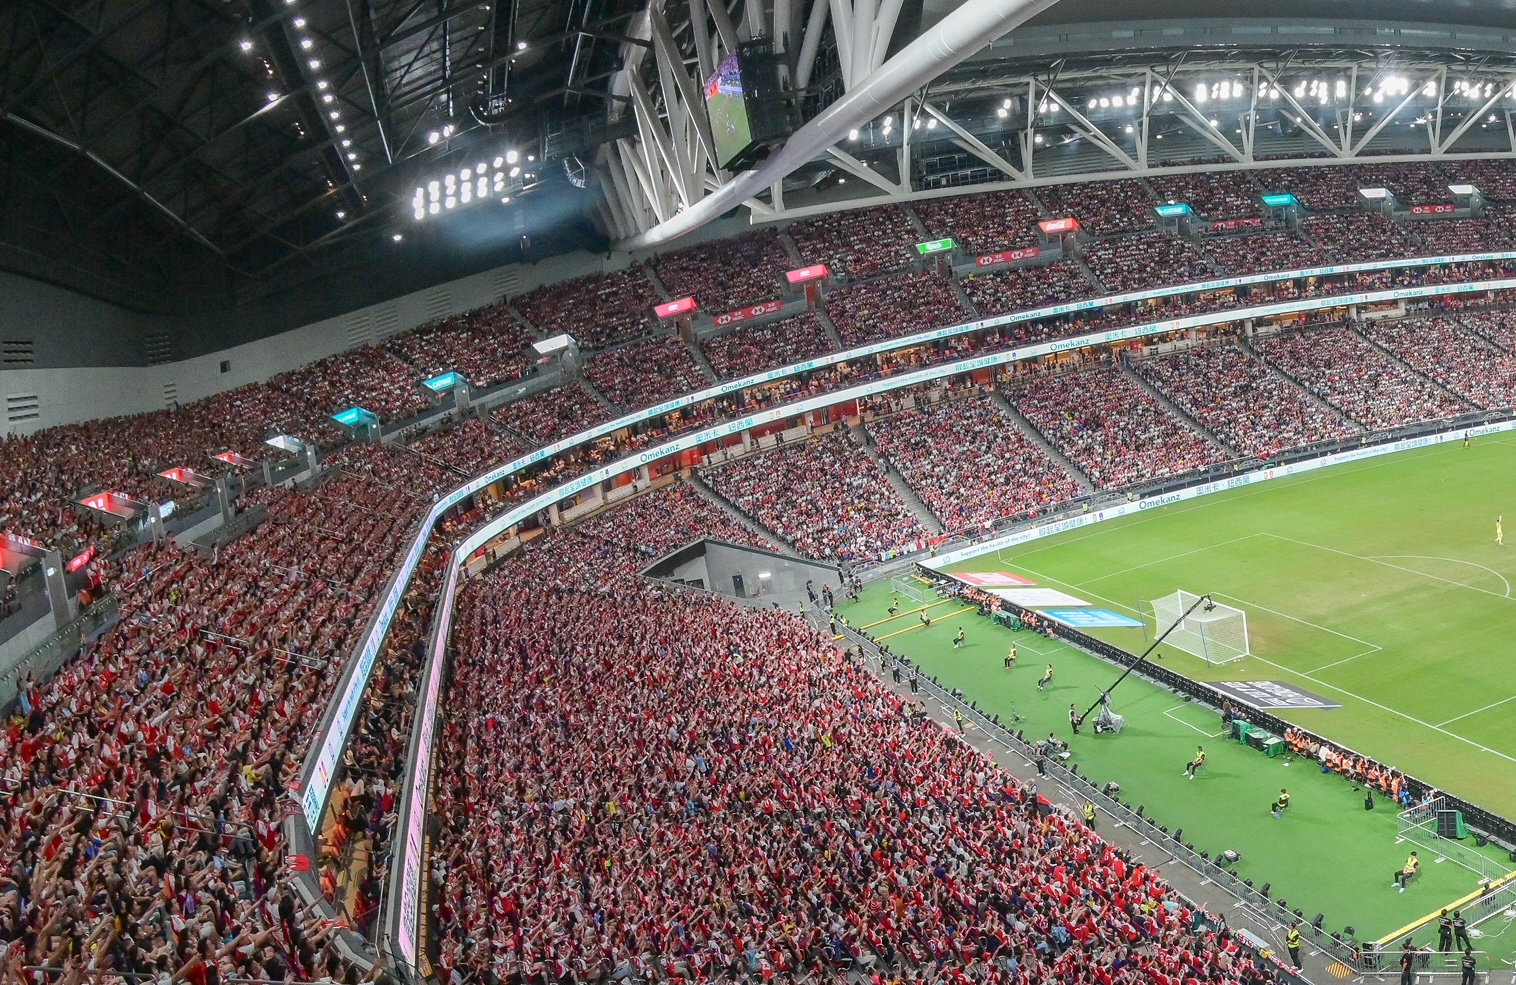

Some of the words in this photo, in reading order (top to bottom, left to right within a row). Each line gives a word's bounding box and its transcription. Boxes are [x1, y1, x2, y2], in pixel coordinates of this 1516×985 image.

[1010, 311, 1041, 322] Omekanz
[1050, 338, 1090, 351] Omekanz
[721, 378, 754, 393] Omekanz
[1469, 425, 1500, 437] Omekanz
[640, 443, 680, 463] Omekanz
[1139, 493, 1181, 510] Omekanz
